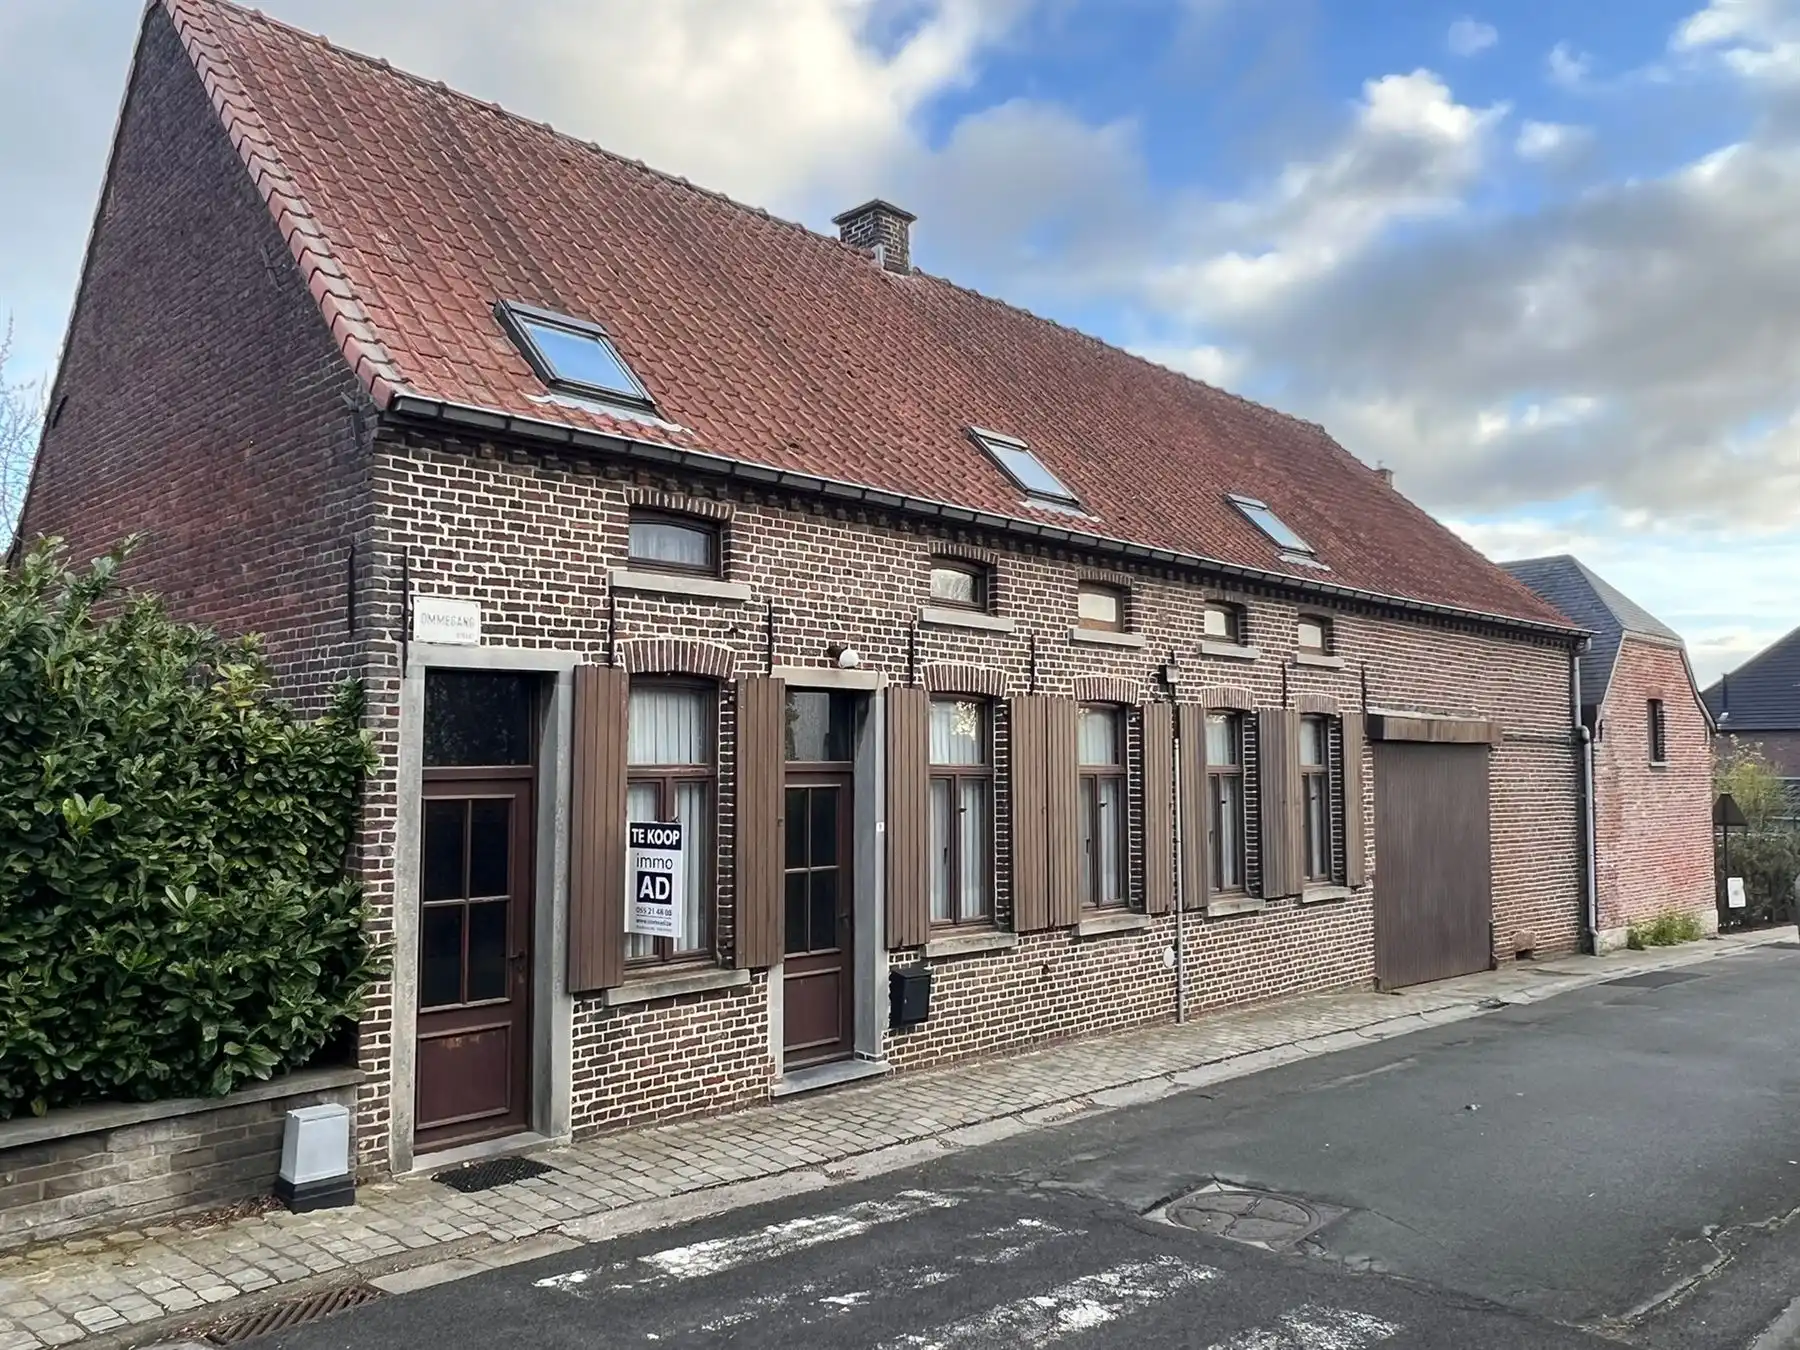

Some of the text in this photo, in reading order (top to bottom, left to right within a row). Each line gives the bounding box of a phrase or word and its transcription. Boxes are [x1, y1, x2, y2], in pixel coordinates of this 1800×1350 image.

[420, 612, 475, 628] OMMEGANG
[631, 828, 680, 846] TE KOOP
[636, 852, 673, 870] immo
[639, 875, 670, 900] AD
[648, 907, 655, 915] 21
